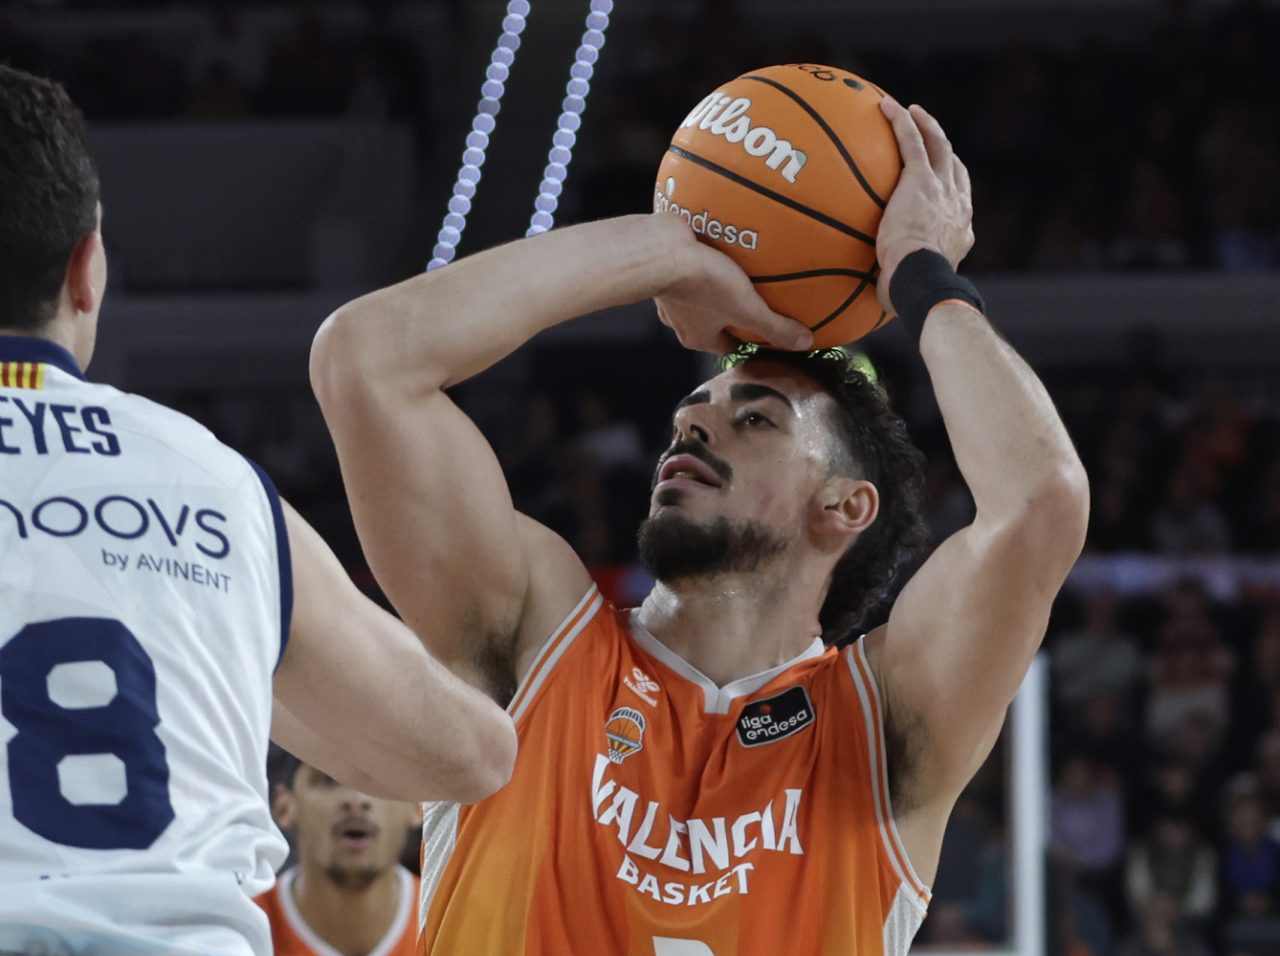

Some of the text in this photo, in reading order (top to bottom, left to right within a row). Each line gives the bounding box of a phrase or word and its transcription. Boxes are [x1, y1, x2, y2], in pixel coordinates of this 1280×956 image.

[101, 549, 232, 593] by AVINENT
[741, 711, 773, 735] liga
[746, 708, 809, 740] endesa
[592, 753, 804, 874] VALENCIA
[617, 854, 755, 906] BASKET
